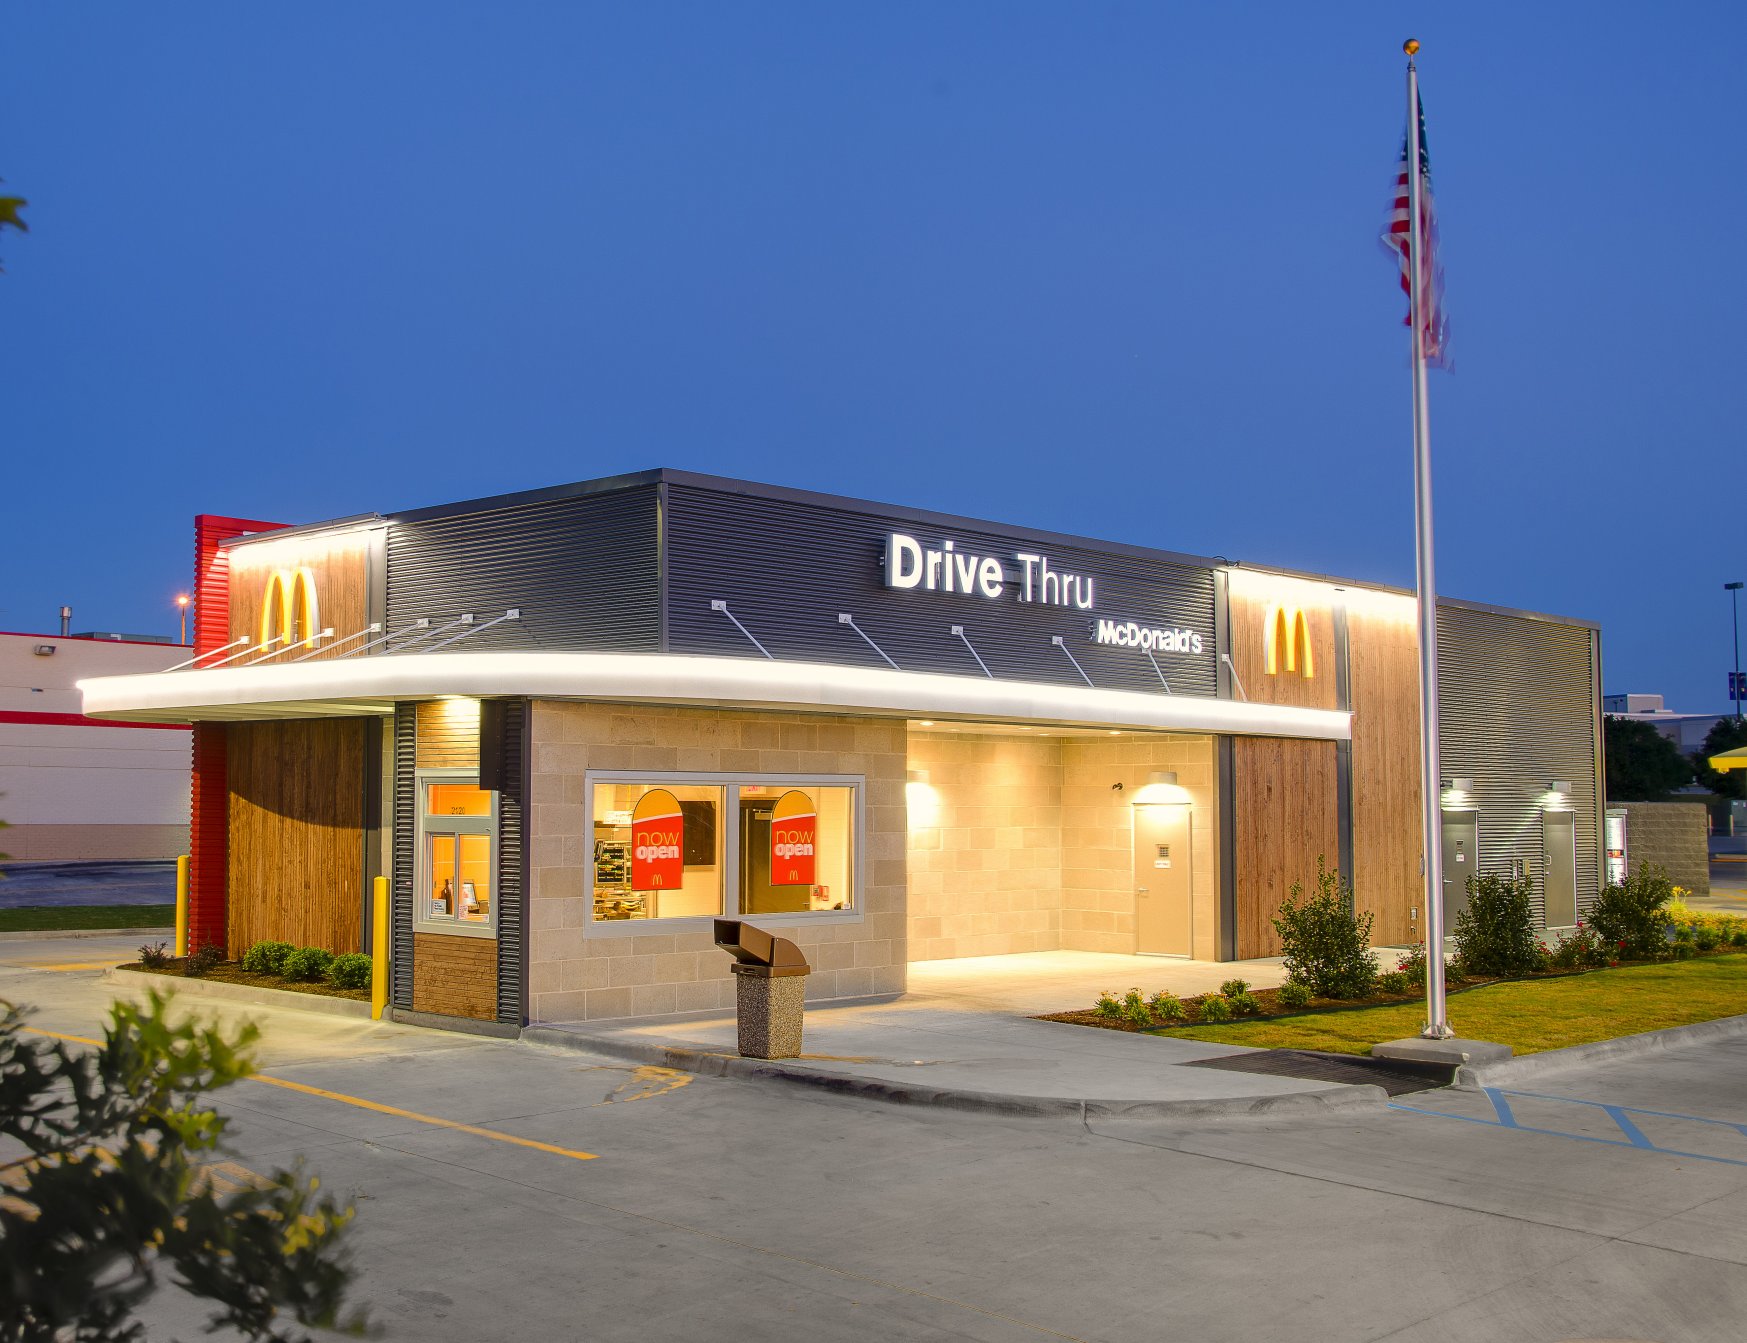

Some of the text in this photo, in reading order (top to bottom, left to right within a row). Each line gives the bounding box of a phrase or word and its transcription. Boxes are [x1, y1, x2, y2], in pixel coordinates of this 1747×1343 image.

[888, 533, 1094, 608] Drive Thru
[1096, 619, 1204, 654] McDonald's
[637, 831, 680, 846] now
[775, 829, 814, 844] now
[635, 845, 680, 863] open
[774, 843, 814, 859] open
